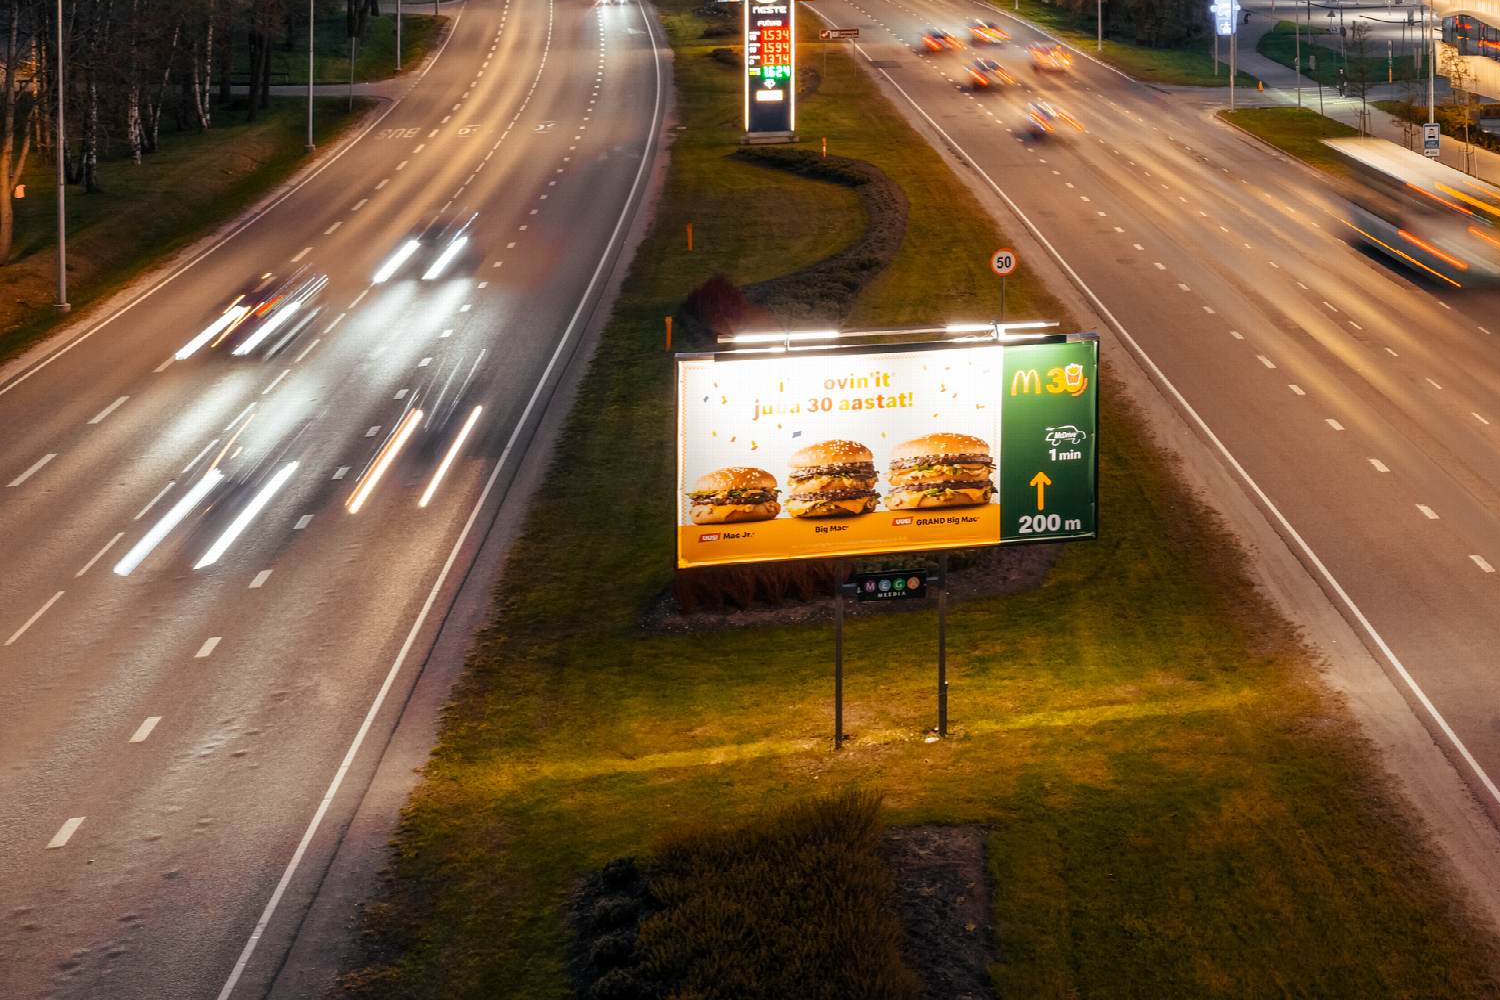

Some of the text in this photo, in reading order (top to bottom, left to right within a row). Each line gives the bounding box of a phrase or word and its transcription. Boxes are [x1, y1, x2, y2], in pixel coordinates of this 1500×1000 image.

[997, 256, 1011, 268] 50
[807, 397, 833, 412] 30
[838, 391, 913, 411] aastat!
[1048, 448, 1081, 461] 1 min
[916, 517, 945, 526] GRAND
[947, 516, 959, 525] Big
[1019, 513, 1081, 533] 200 m
[815, 525, 828, 534] Big
[723, 532, 740, 540] Mac
